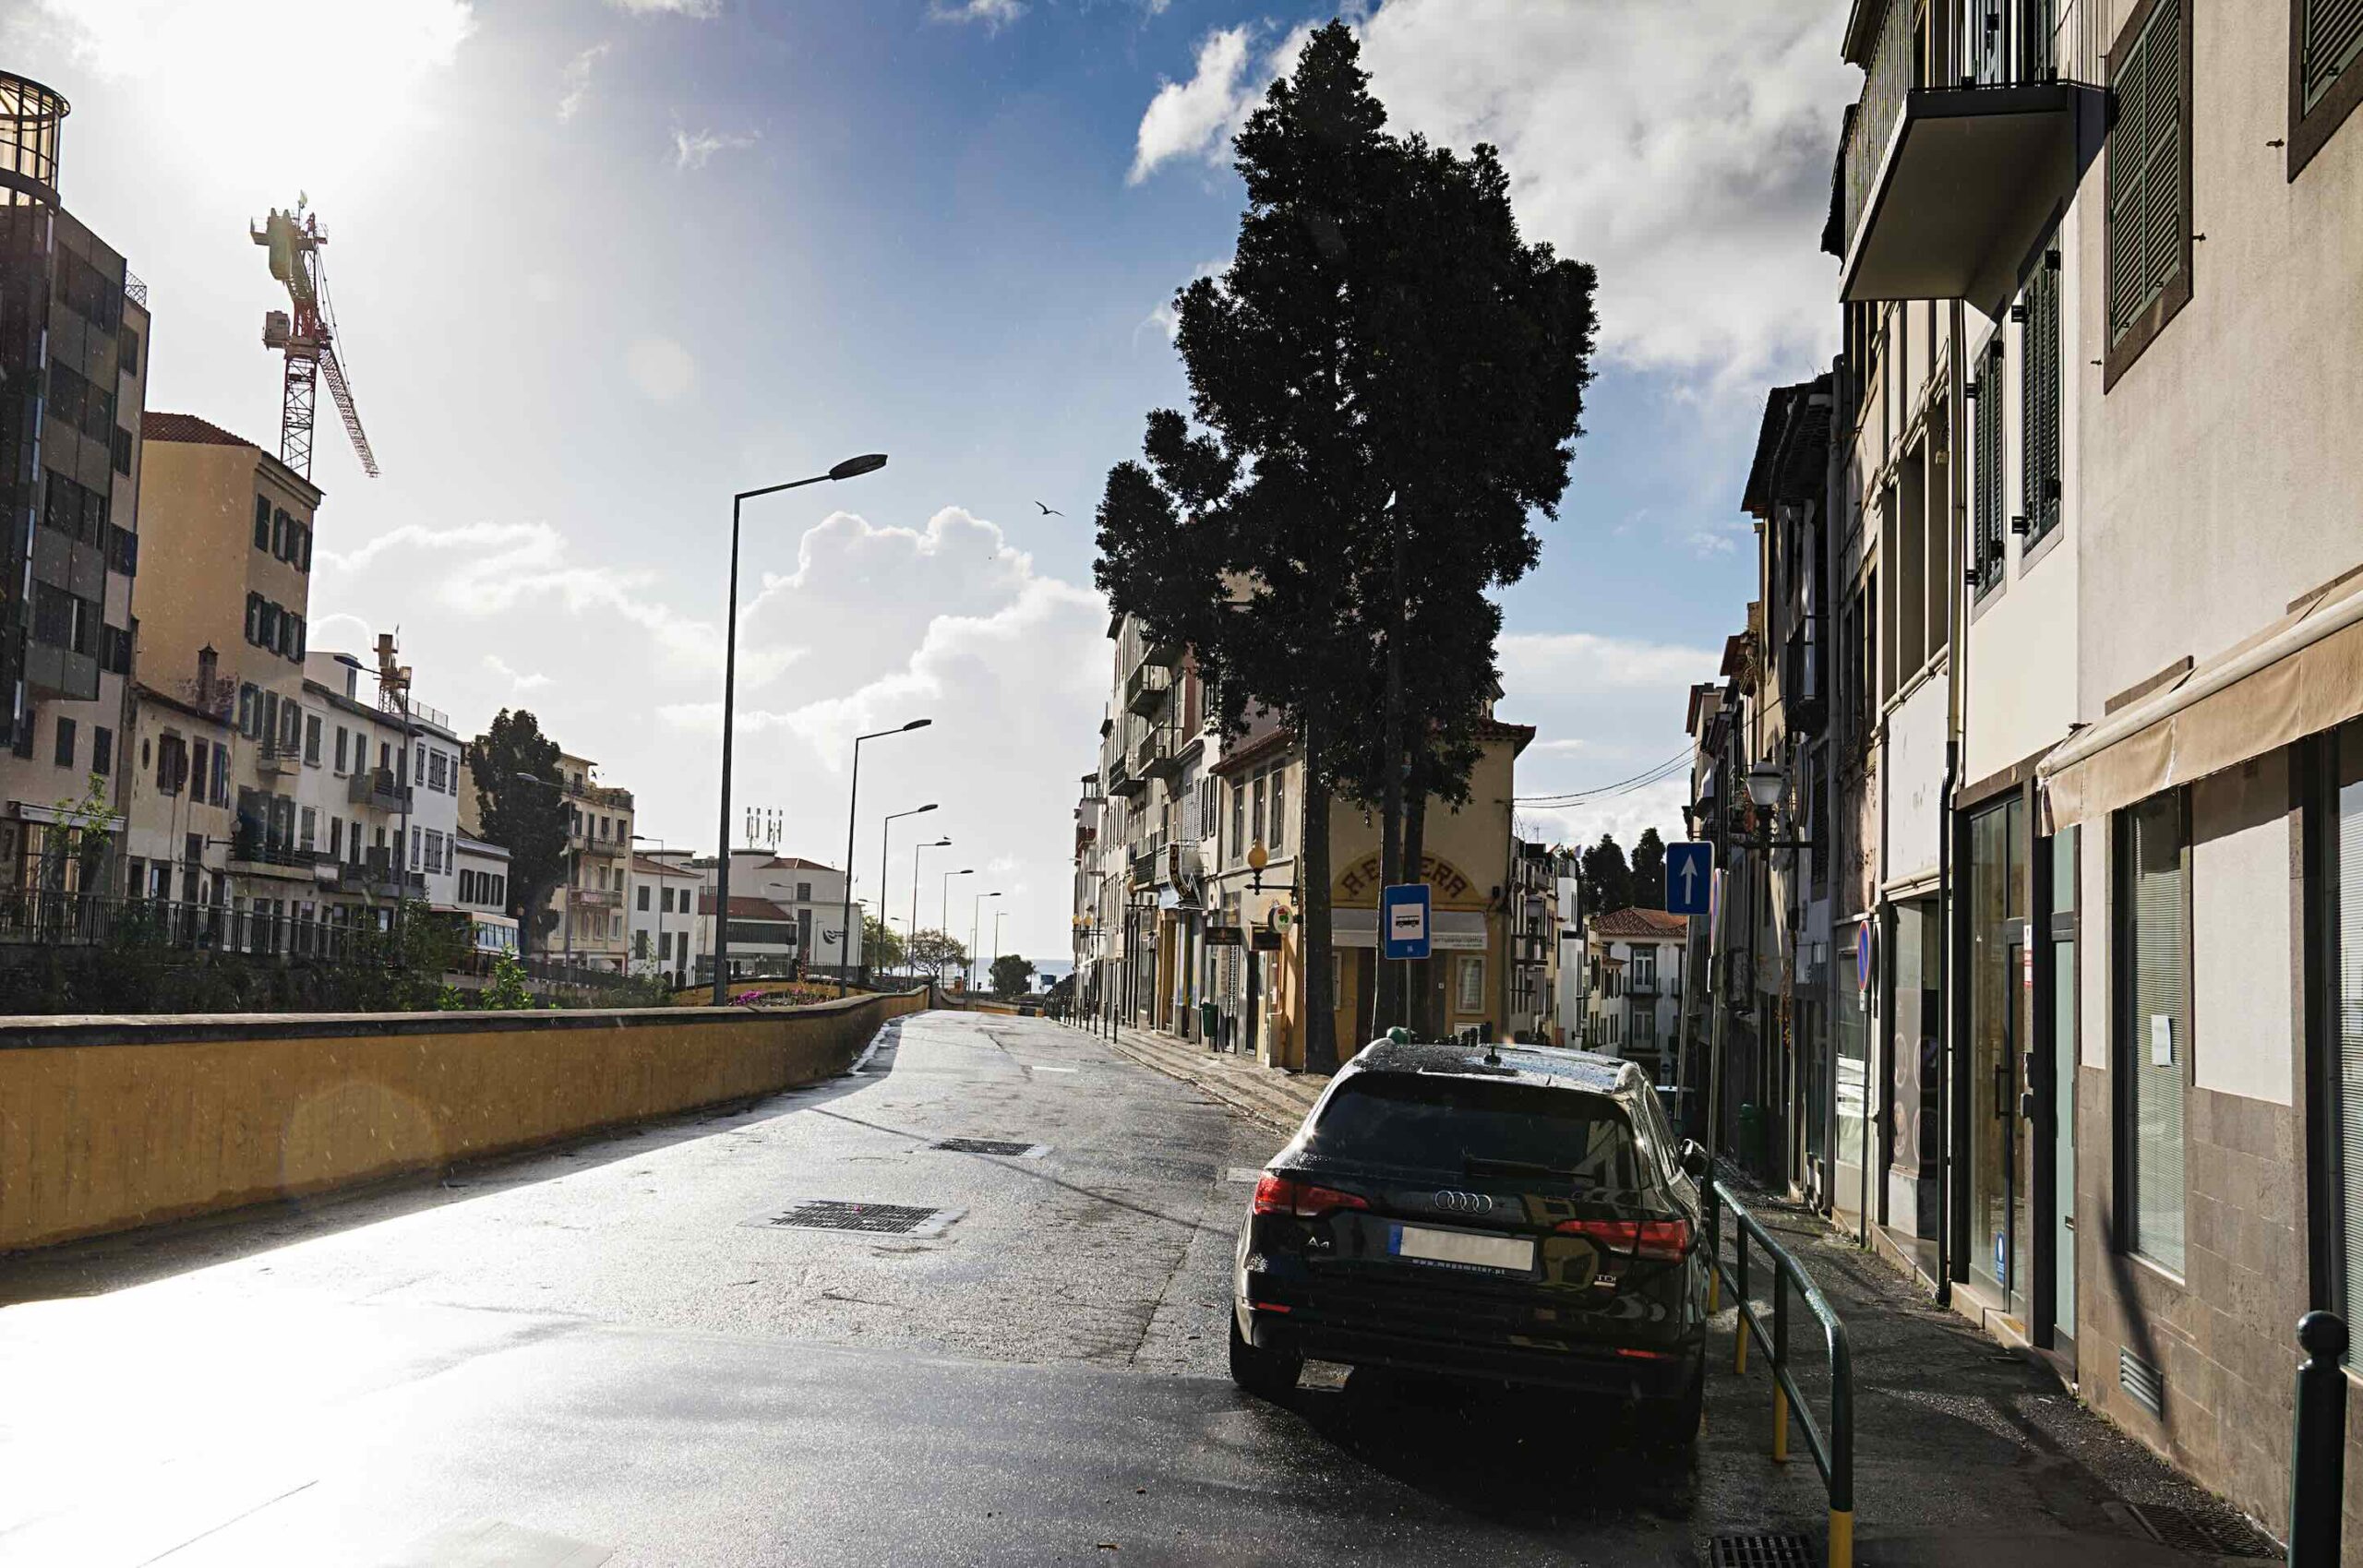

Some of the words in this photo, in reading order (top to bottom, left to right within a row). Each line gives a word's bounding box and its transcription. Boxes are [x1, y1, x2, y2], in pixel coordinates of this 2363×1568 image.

[1170, 846, 1188, 897] OURO
[1307, 1236, 1330, 1249] A4
[1596, 1274, 1617, 1283] TDI
